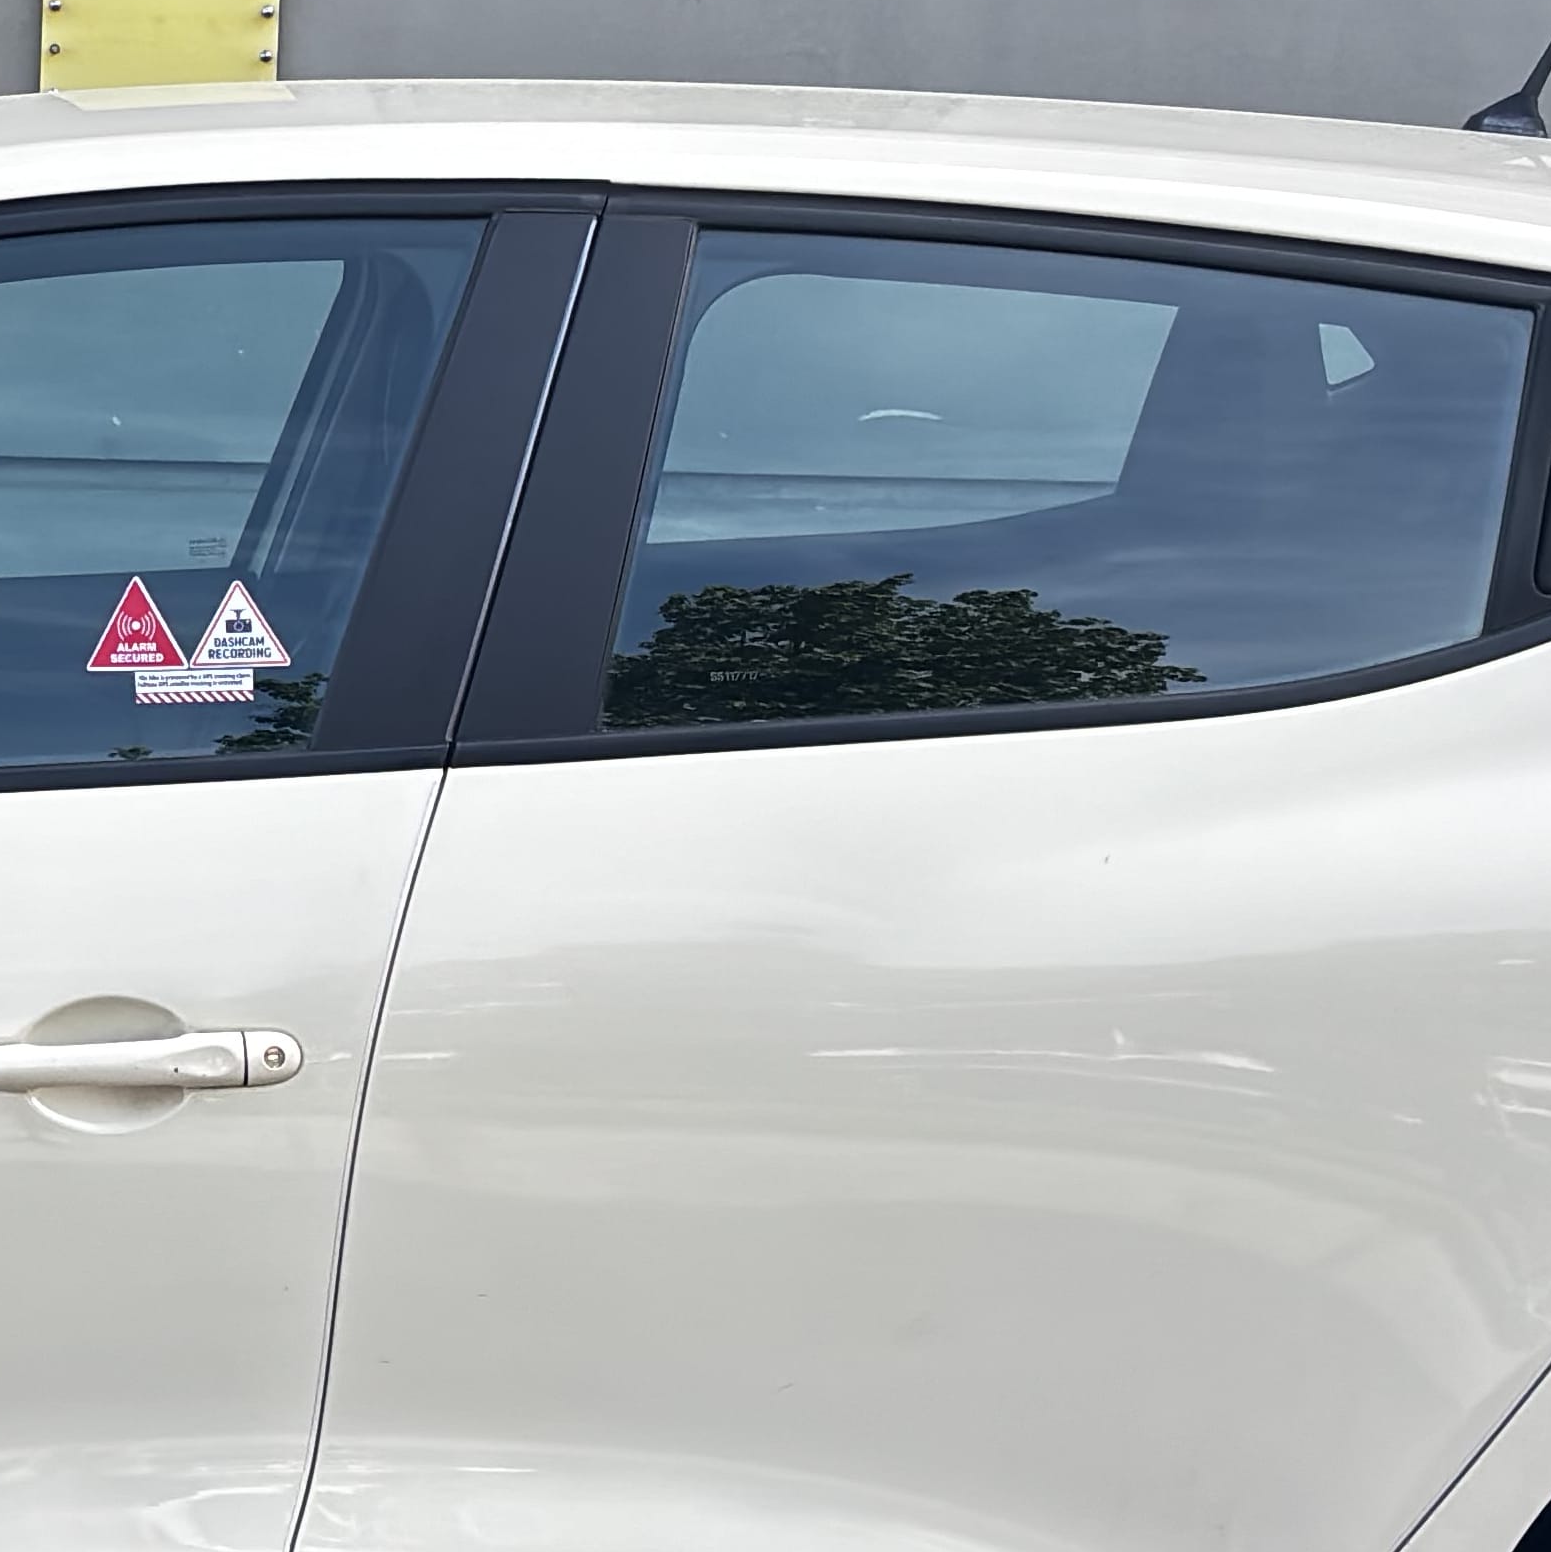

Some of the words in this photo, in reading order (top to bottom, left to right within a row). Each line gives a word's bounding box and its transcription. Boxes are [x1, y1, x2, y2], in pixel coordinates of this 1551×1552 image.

[116, 642, 157, 652] ALARM
[213, 636, 265, 648] DASHCAM
[110, 652, 164, 664] SECURED
[208, 647, 272, 660] RECORDING
